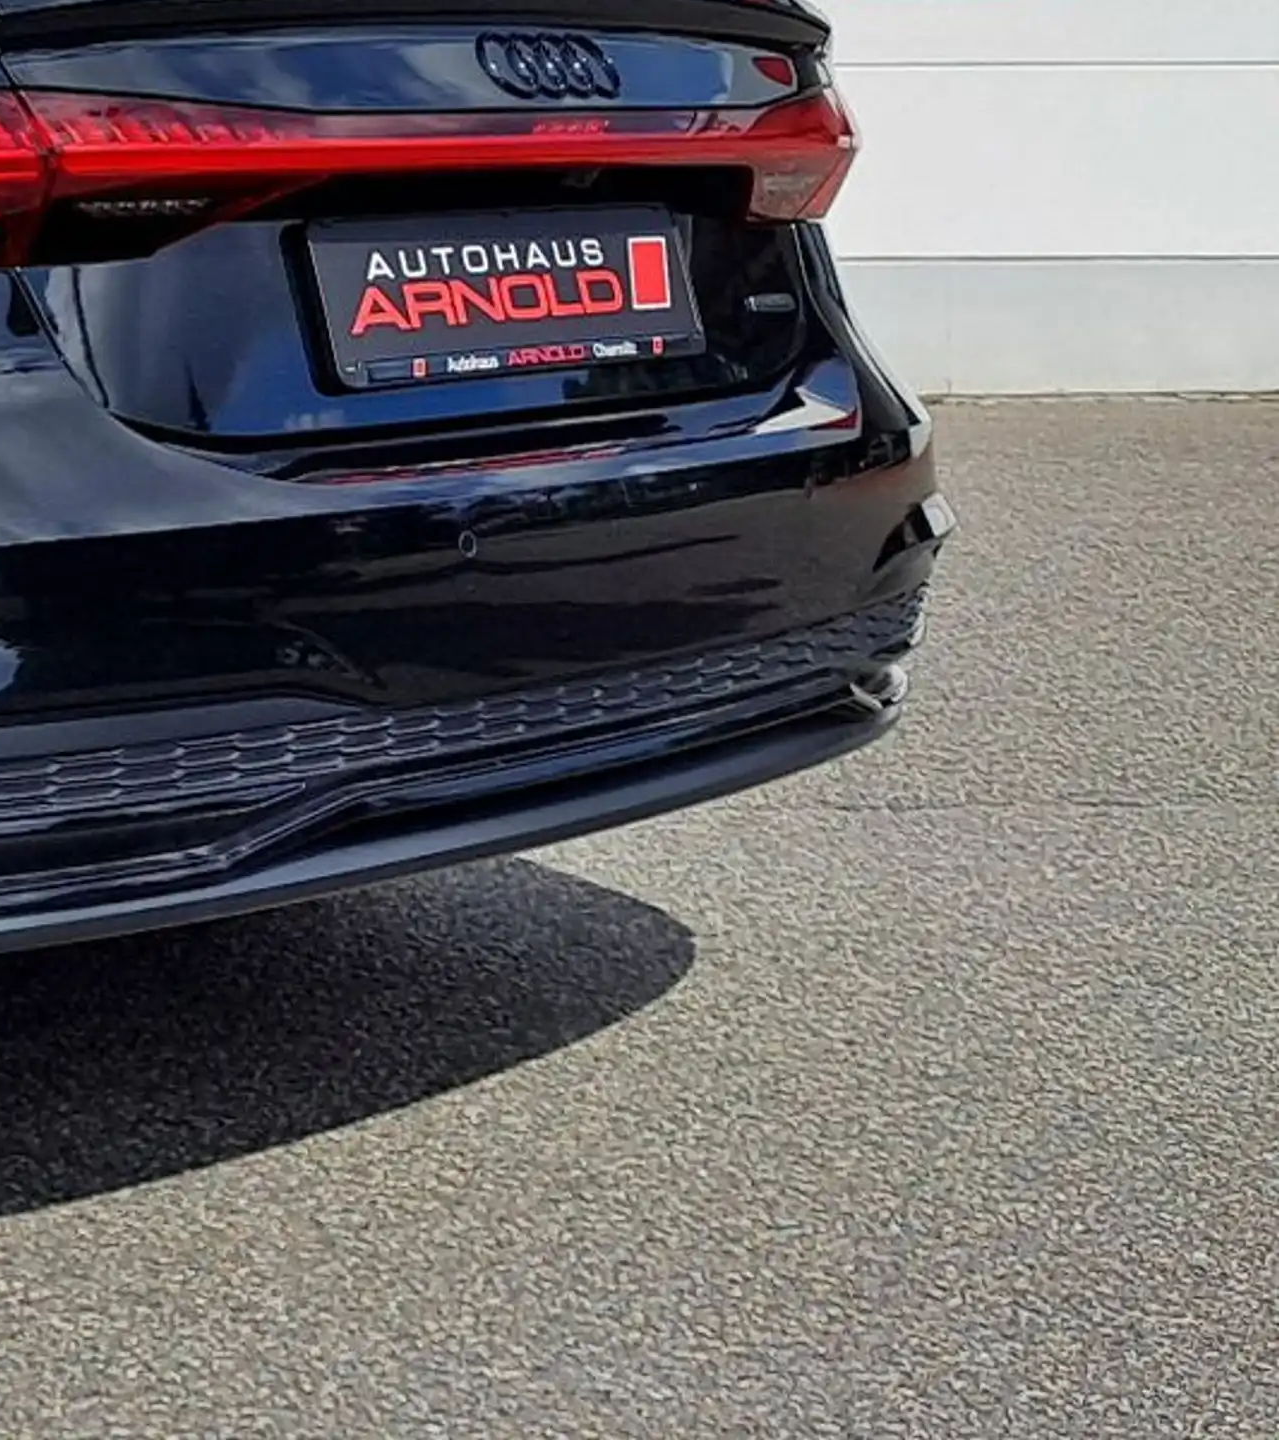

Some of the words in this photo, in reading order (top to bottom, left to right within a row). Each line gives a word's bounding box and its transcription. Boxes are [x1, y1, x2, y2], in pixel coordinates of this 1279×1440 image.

[366, 238, 605, 282] AUTOHAUS
[351, 268, 624, 335] ARNOLD
[506, 344, 586, 366] ARNOLD
